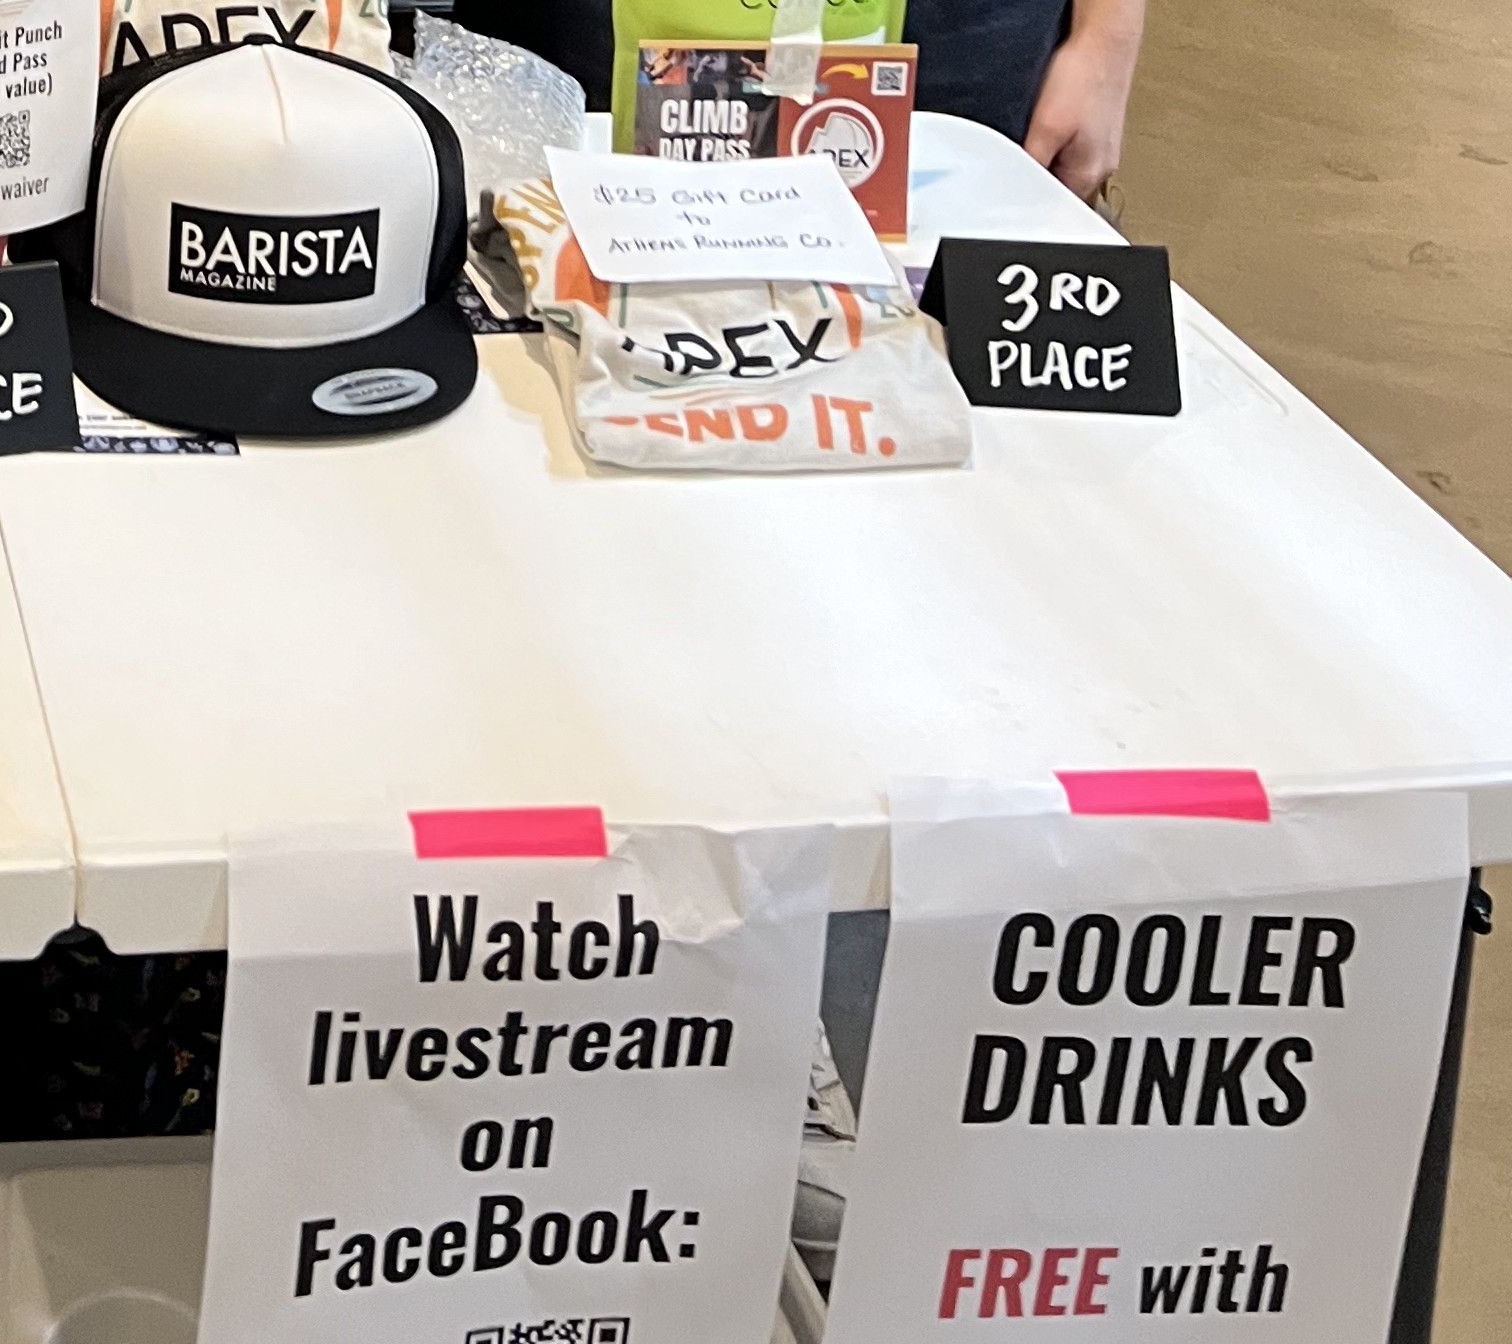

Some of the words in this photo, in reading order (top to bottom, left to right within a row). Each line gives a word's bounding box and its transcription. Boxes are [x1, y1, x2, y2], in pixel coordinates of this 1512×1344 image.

[15, 20, 63, 47] Punch
[5, 72, 53, 100] value)
[12, 50, 48, 75] Pass
[660, 99, 749, 135] CLIMB
[659, 137, 696, 162] DAY
[700, 137, 751, 163] PASS
[0, 175, 50, 202] waiver
[594, 184, 656, 205] $25
[671, 186, 729, 205] Gift
[740, 185, 802, 204] Card
[179, 220, 374, 279] BARISTA
[180, 266, 277, 293] MAGAZINE
[996, 263, 1122, 333] 3RD
[987, 340, 1133, 392] PLACE
[812, 393, 897, 457] IT.
[413, 893, 661, 984] Watch
[992, 911, 1356, 1009] COOLER
[307, 1010, 734, 1087] livestream
[960, 1034, 1314, 1128] DRINKS
[460, 1116, 554, 1173] on
[293, 1189, 701, 1299] FaceBook:
[936, 1247, 1120, 1320] FREE
[1138, 1244, 1291, 1315] with
